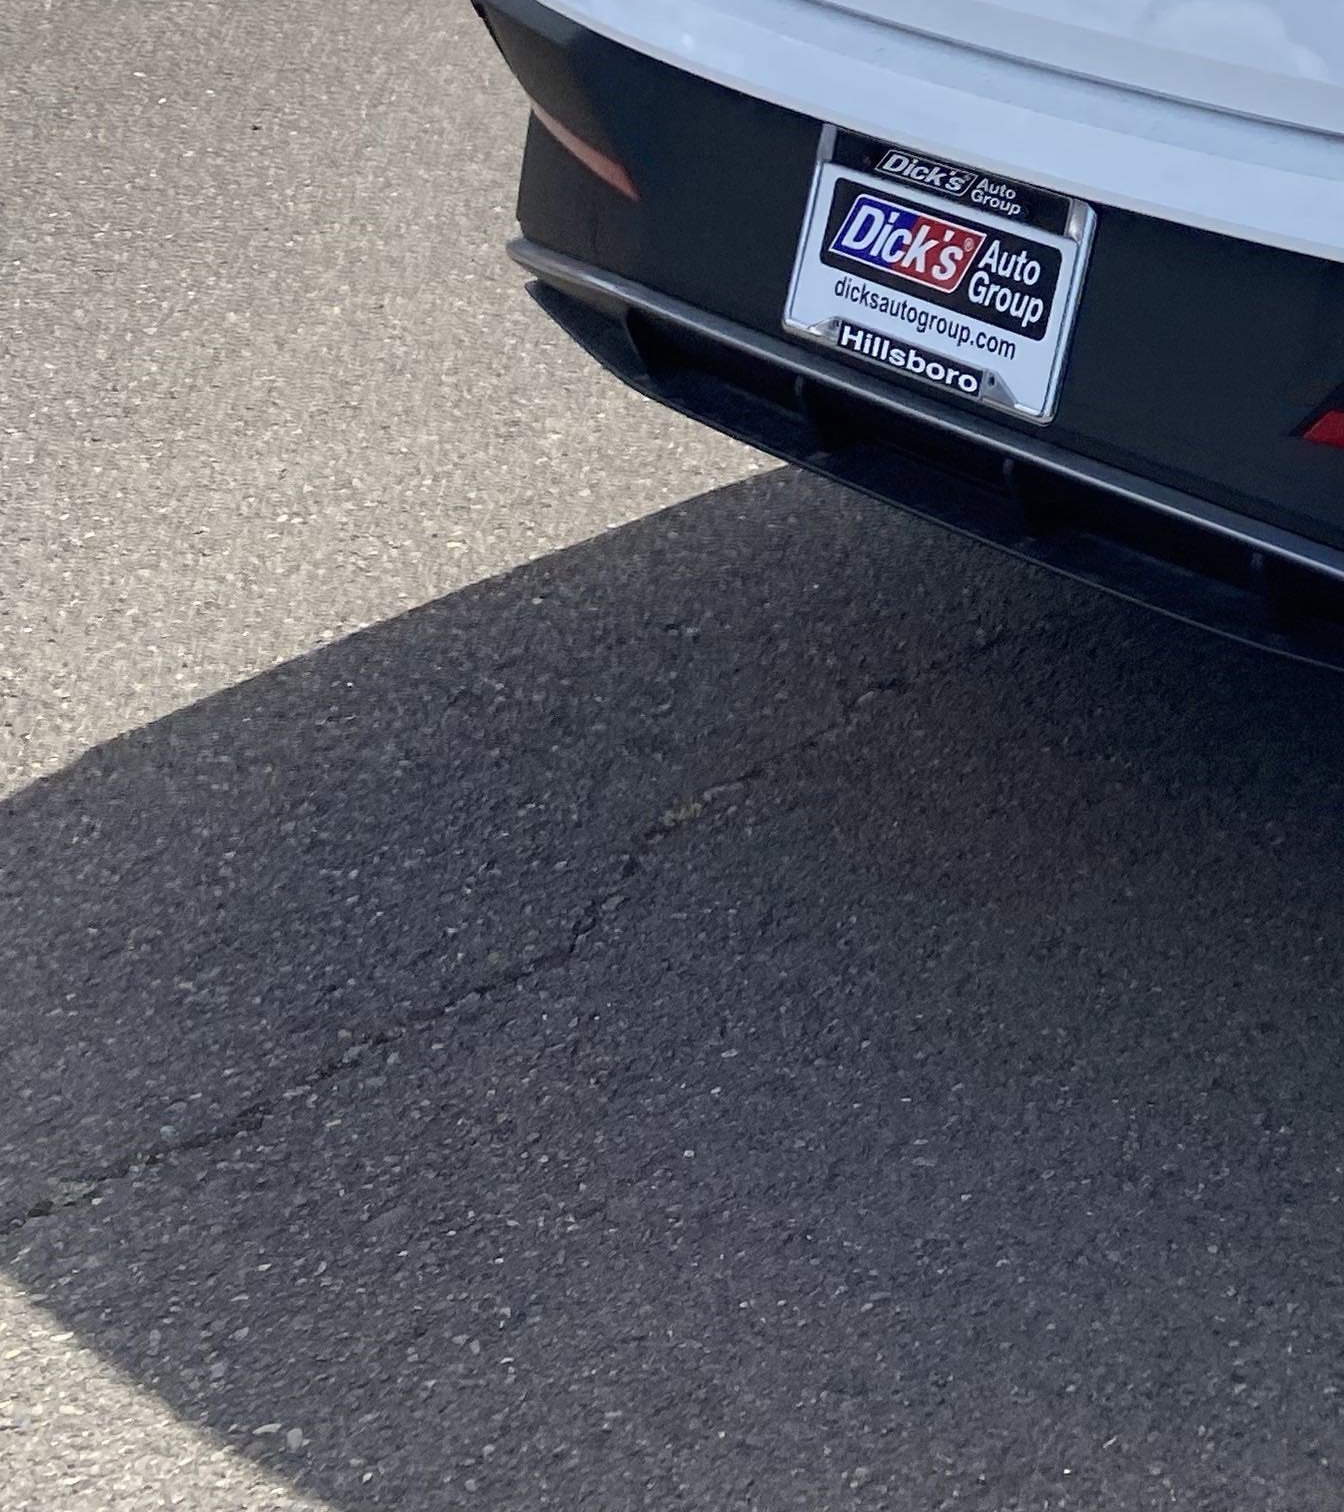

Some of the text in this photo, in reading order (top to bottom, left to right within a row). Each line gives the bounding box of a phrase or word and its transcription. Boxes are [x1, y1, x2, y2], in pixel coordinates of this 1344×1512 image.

[882, 153, 966, 191] Dick's
[976, 178, 1017, 200] Auto
[971, 189, 1022, 216] Group
[841, 204, 965, 281] Dick's
[978, 240, 1041, 285] Auto
[834, 276, 1017, 361] dicksautogroup.com
[968, 270, 1044, 328] Group
[840, 325, 979, 393] Hillsboro
